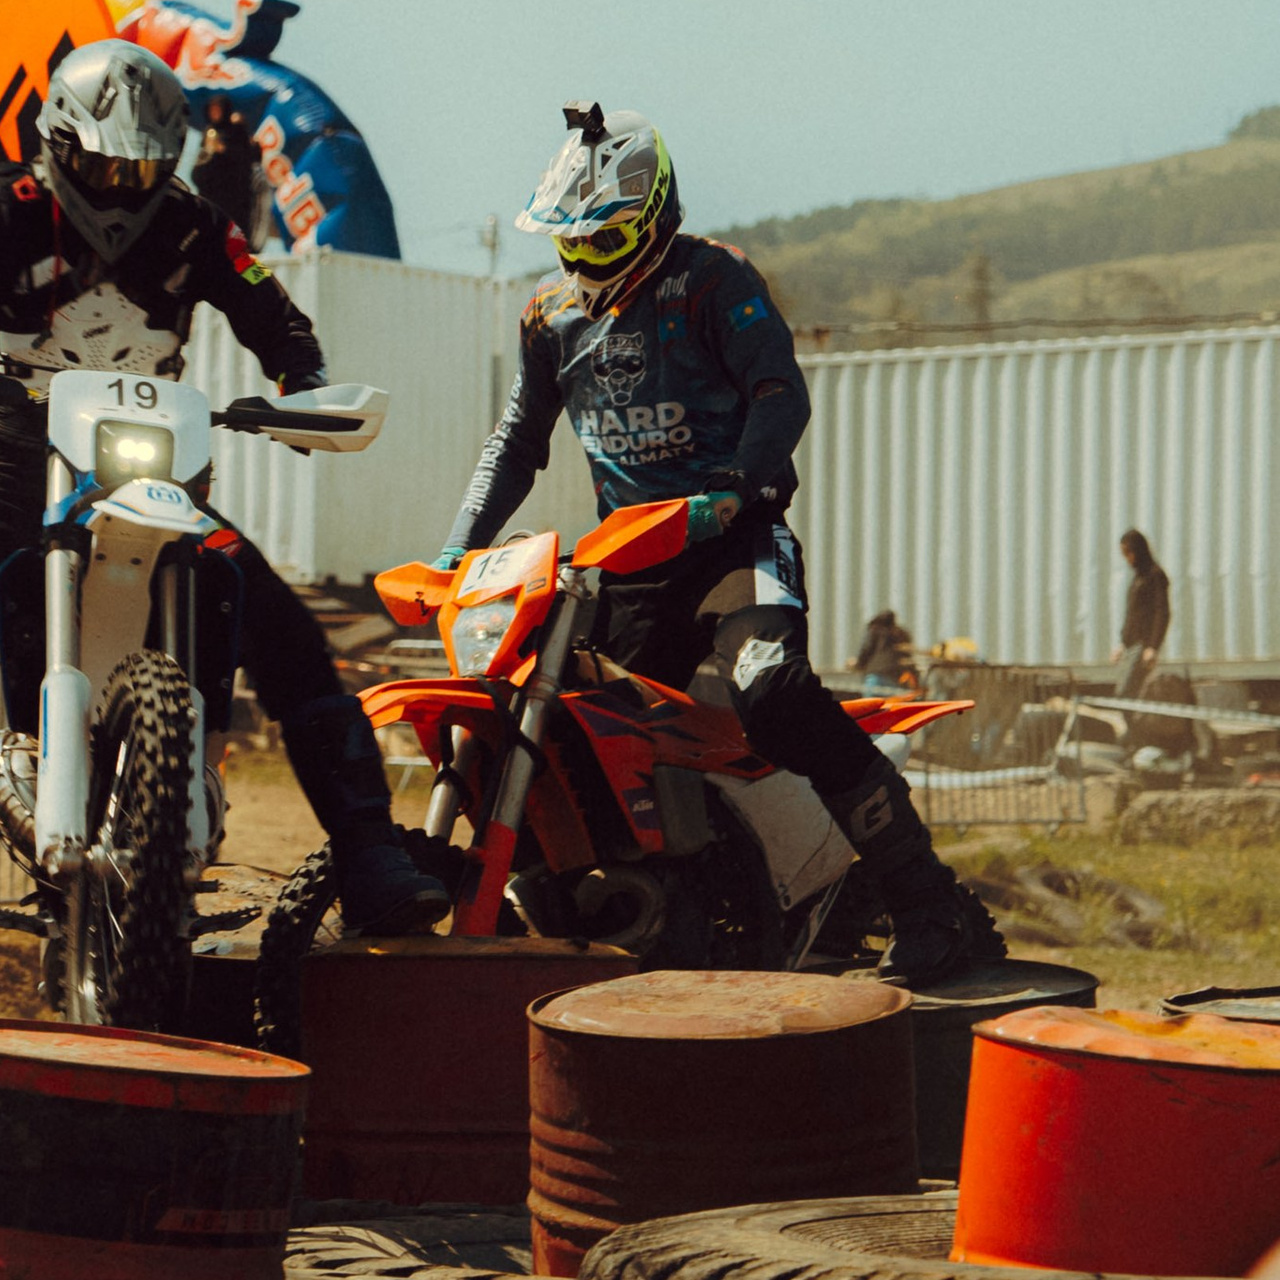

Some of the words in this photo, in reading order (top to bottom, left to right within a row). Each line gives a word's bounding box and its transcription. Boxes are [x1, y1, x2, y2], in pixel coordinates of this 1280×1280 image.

[633, 168, 668, 235] 100%
[107, 378, 158, 410] 19
[580, 401, 685, 435] HARD
[580, 425, 692, 454] ENDURO
[619, 442, 696, 466] ALMATY
[462, 469, 496, 516] HOME
[477, 549, 516, 580] 15
